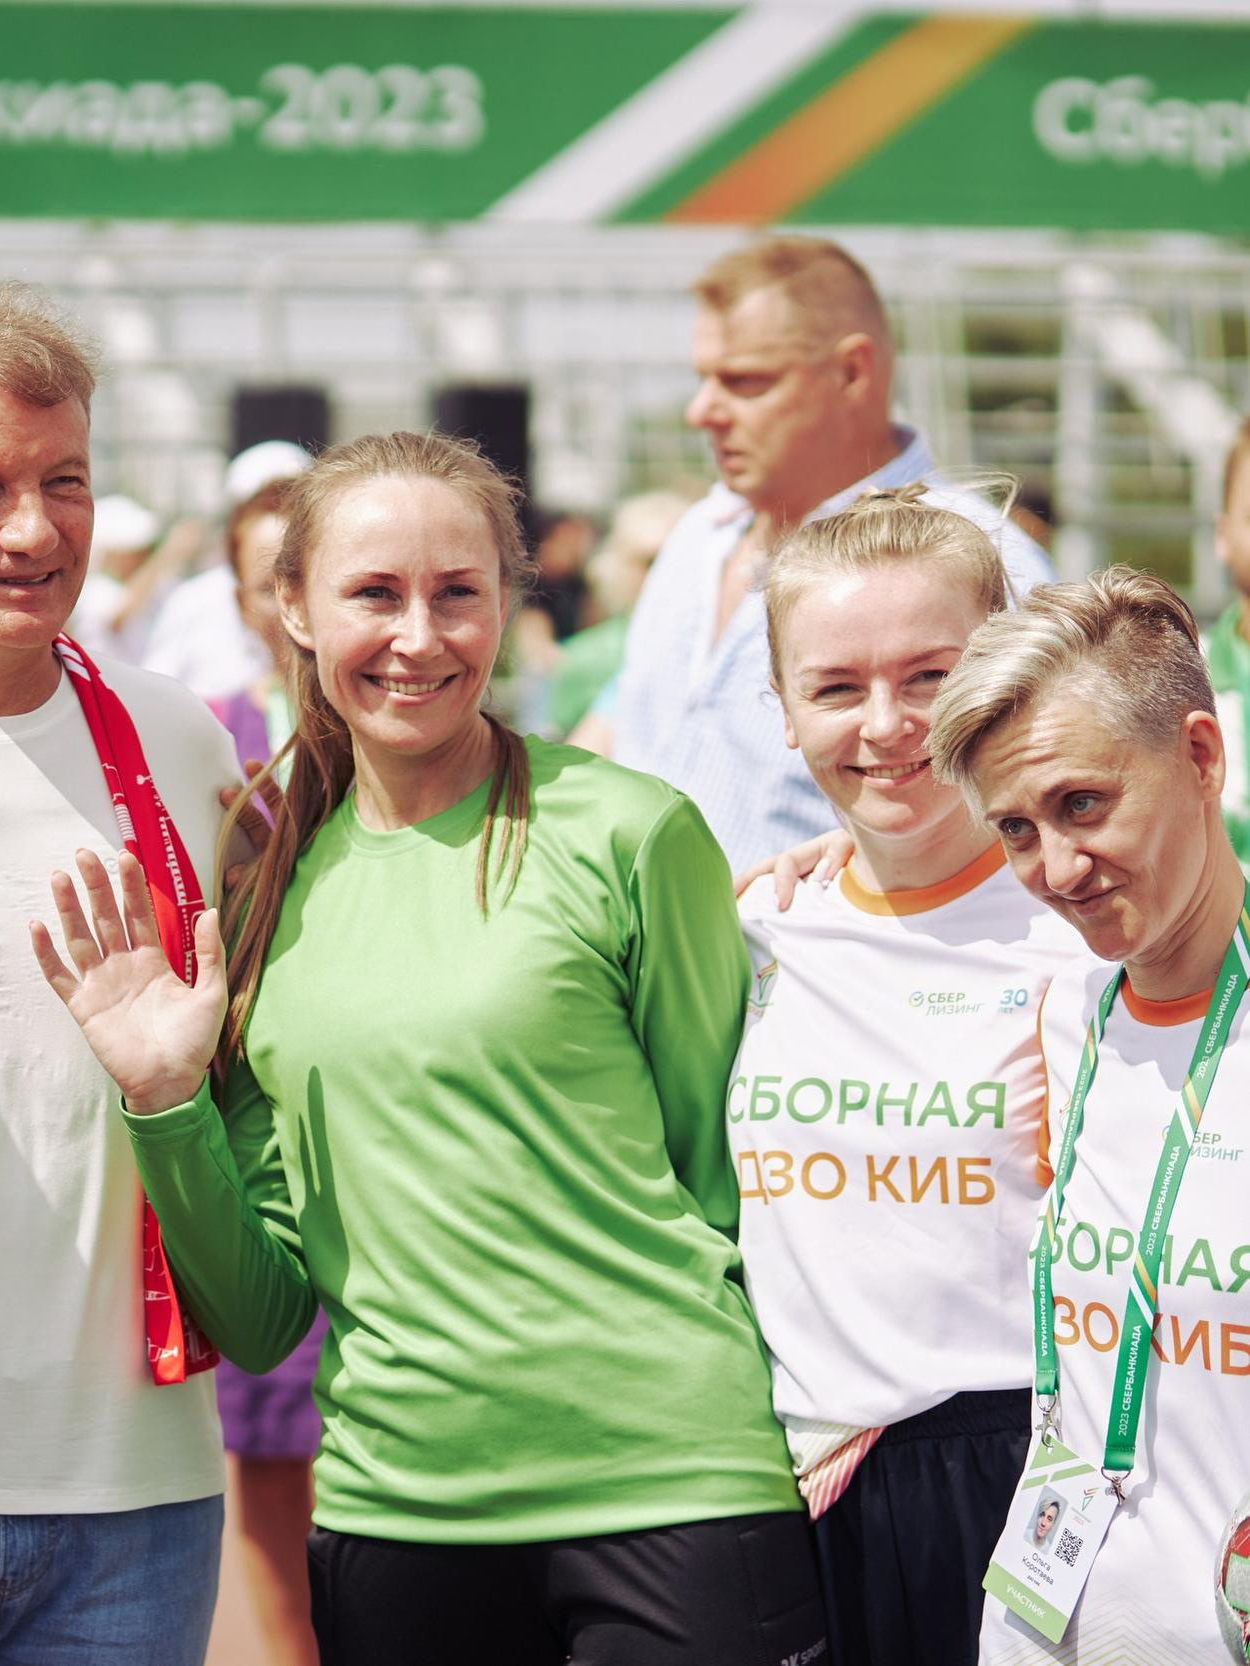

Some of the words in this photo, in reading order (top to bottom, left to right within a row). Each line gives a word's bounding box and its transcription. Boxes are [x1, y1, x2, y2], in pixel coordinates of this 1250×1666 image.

[925, 1003, 985, 1016] ЛИЗИНГ
[928, 993, 966, 1003] СБЕР
[1000, 988, 1029, 1007] 30
[1196, 1055, 1210, 1079] 2023
[1205, 974, 1239, 1054] СБЕРБАНКИАДА
[726, 1075, 1006, 1129] СБОРНАЯ
[1190, 1145, 1244, 1161] ИЗИНГ
[1193, 1131, 1222, 1145] БЕР
[738, 1150, 846, 1206] ДЗО
[865, 1155, 996, 1206] КИБ
[1151, 1145, 1182, 1231] СБЕРБАНКИАДА
[1053, 1295, 1120, 1353] ЗО
[1122, 1325, 1143, 1412] СБЕРБАНКИАДА
[1118, 1412, 1130, 1437] 2023
[1032, 1552, 1051, 1571] Ольга
[1006, 1583, 1046, 1619] УЧАСТНИК
